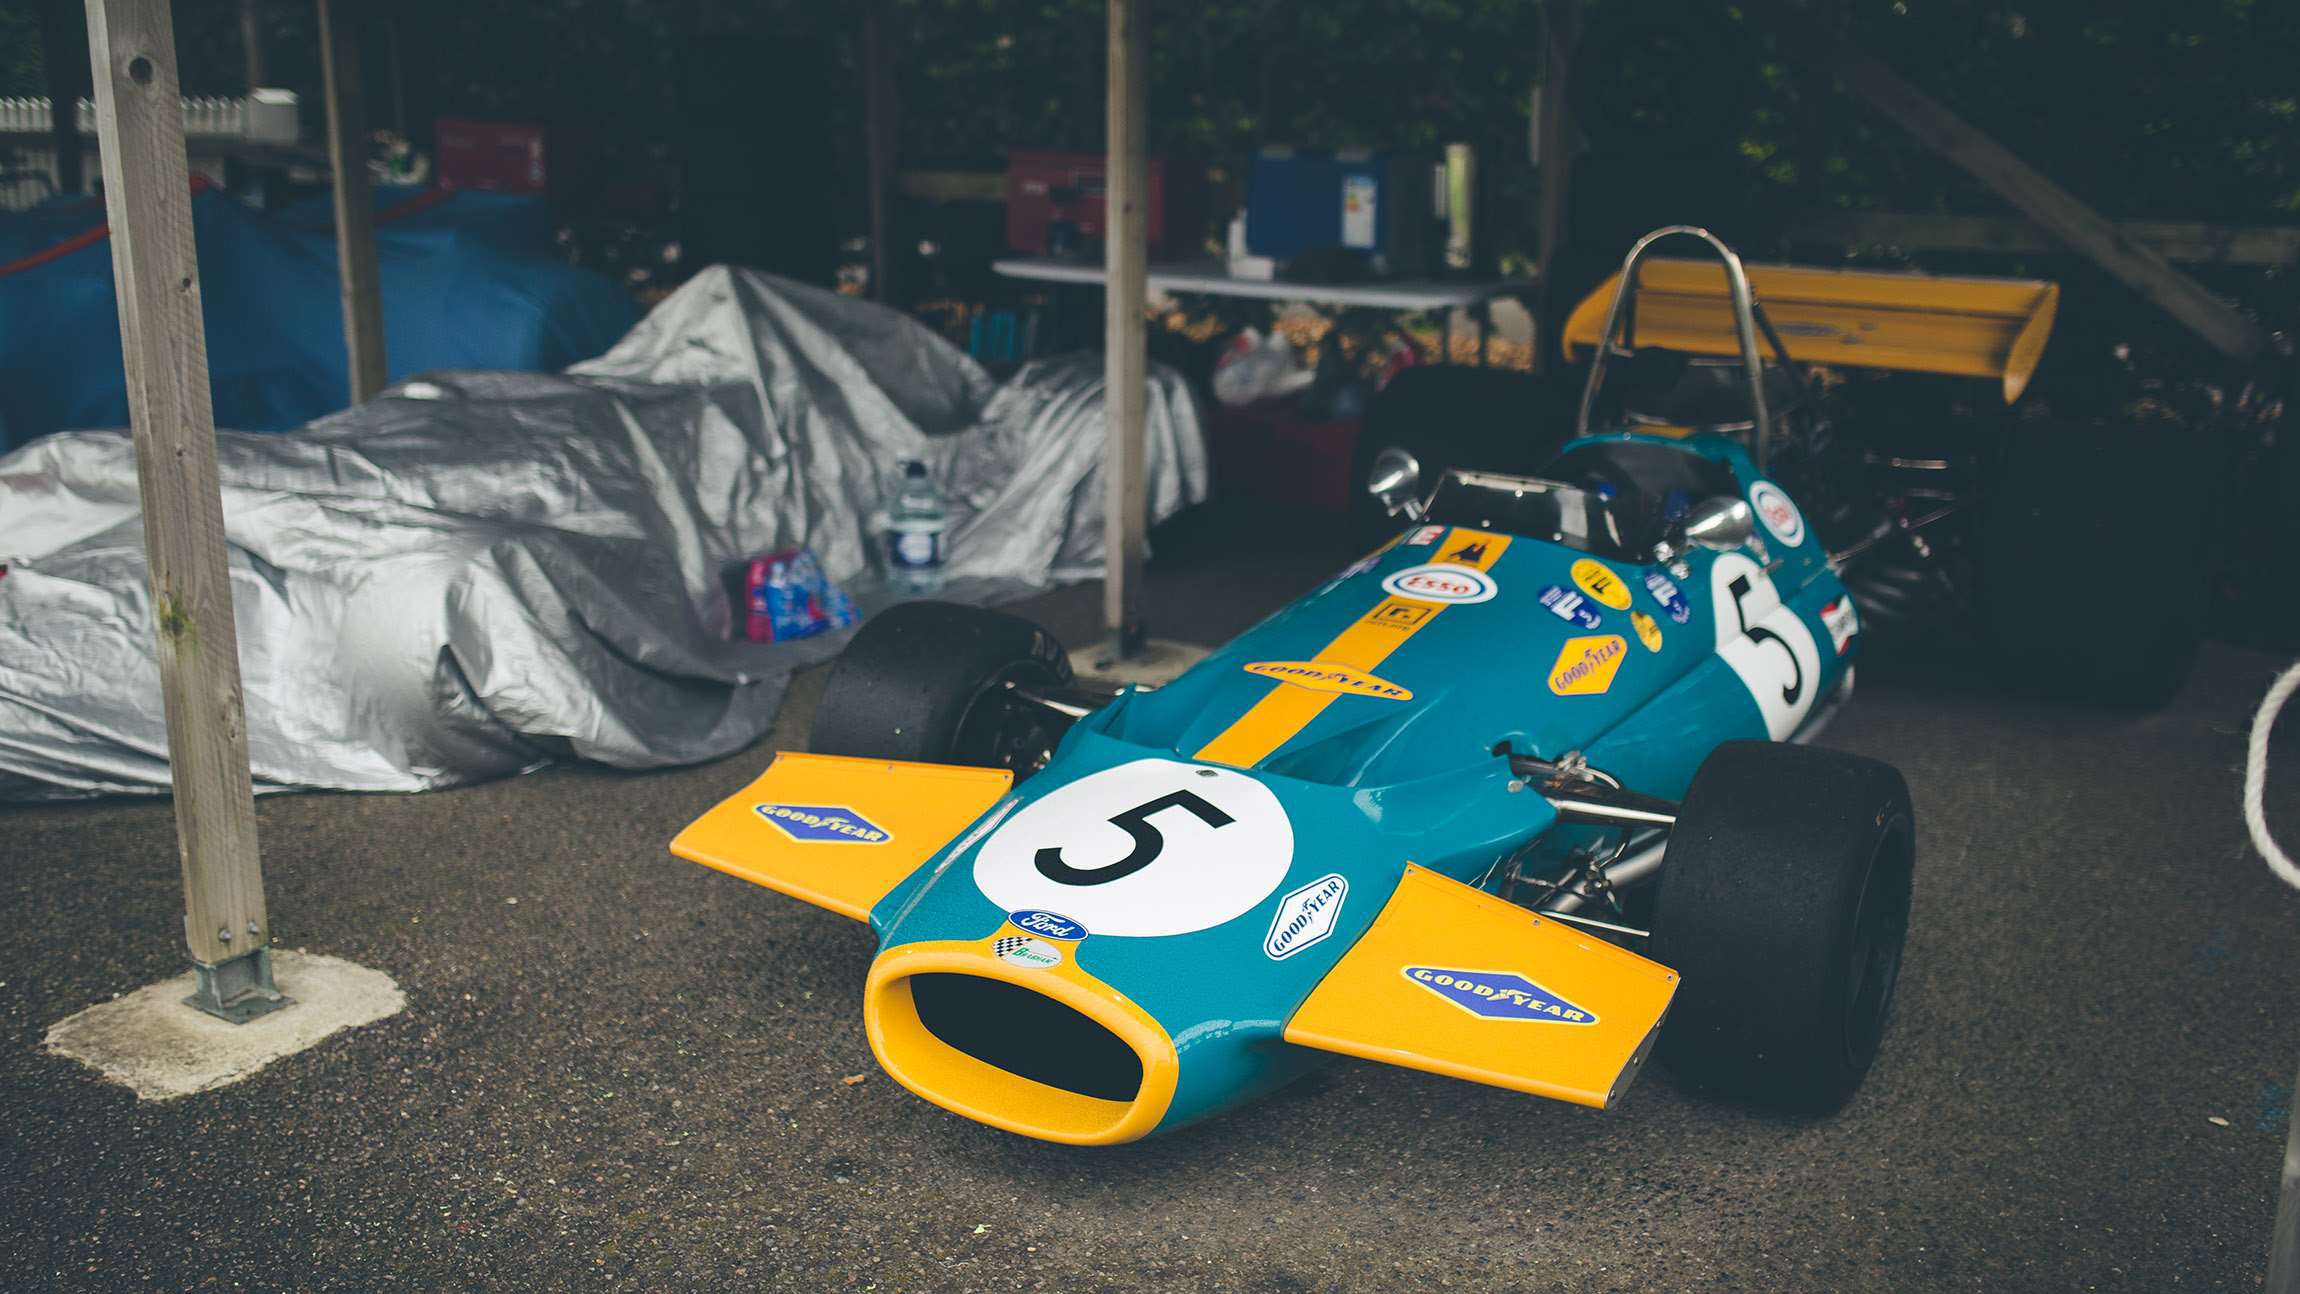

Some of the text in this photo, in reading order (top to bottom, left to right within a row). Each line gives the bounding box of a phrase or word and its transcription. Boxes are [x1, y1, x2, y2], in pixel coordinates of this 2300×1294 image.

[1728, 574, 1801, 705] 5
[761, 804, 885, 842] GOODYEAR
[1034, 789, 1237, 886] 5
[1020, 912, 1075, 937] Ford
[1273, 880, 1341, 952] GOODYEAR
[1413, 968, 1586, 1023] GOODYEAR
